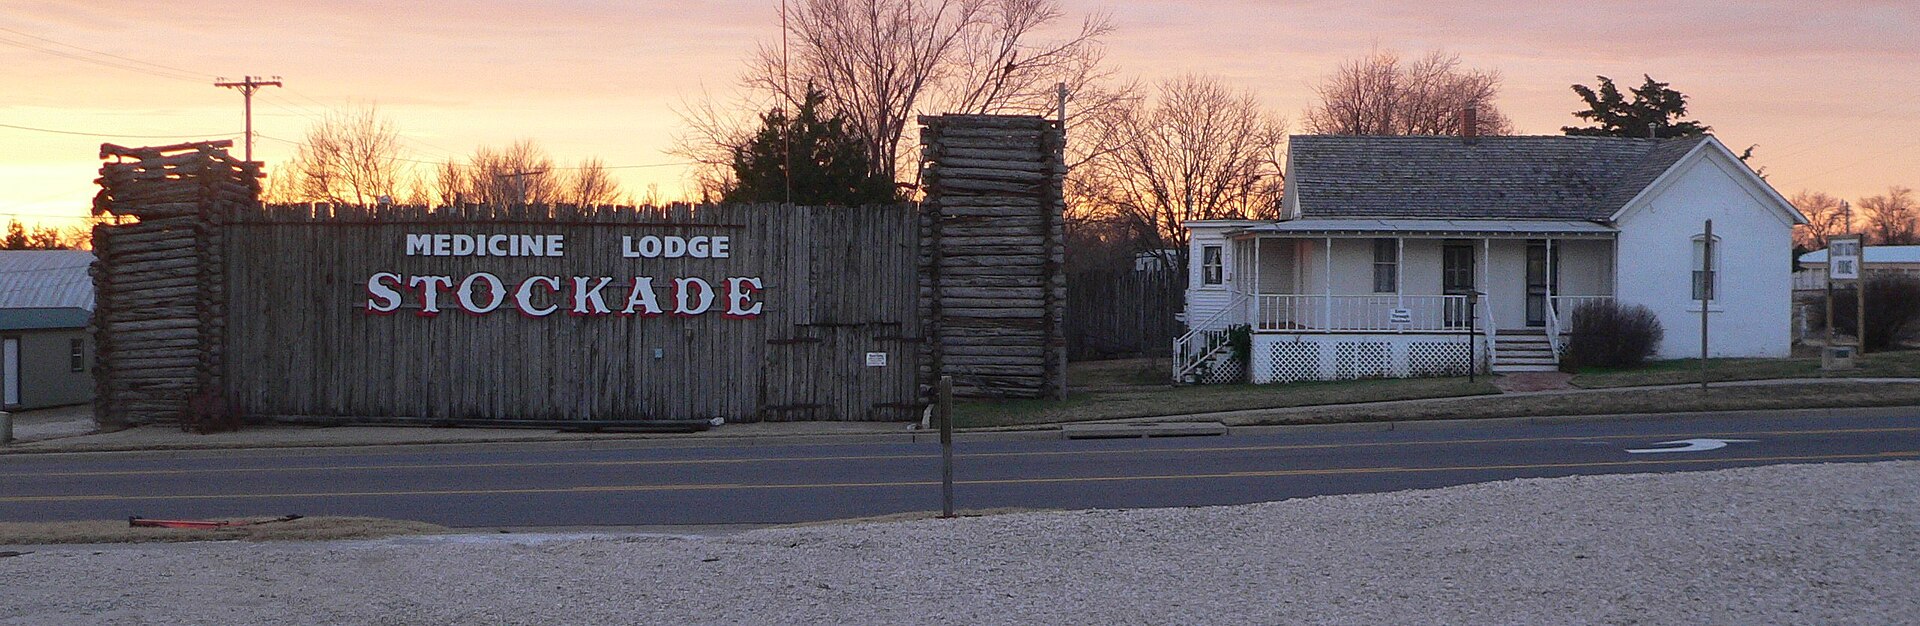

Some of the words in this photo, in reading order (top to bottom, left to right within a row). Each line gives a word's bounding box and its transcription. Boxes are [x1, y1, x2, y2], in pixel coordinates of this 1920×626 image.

[406, 233, 564, 257] MEDICINE
[622, 235, 729, 258] LODGE
[367, 271, 763, 317] STOCKADE
